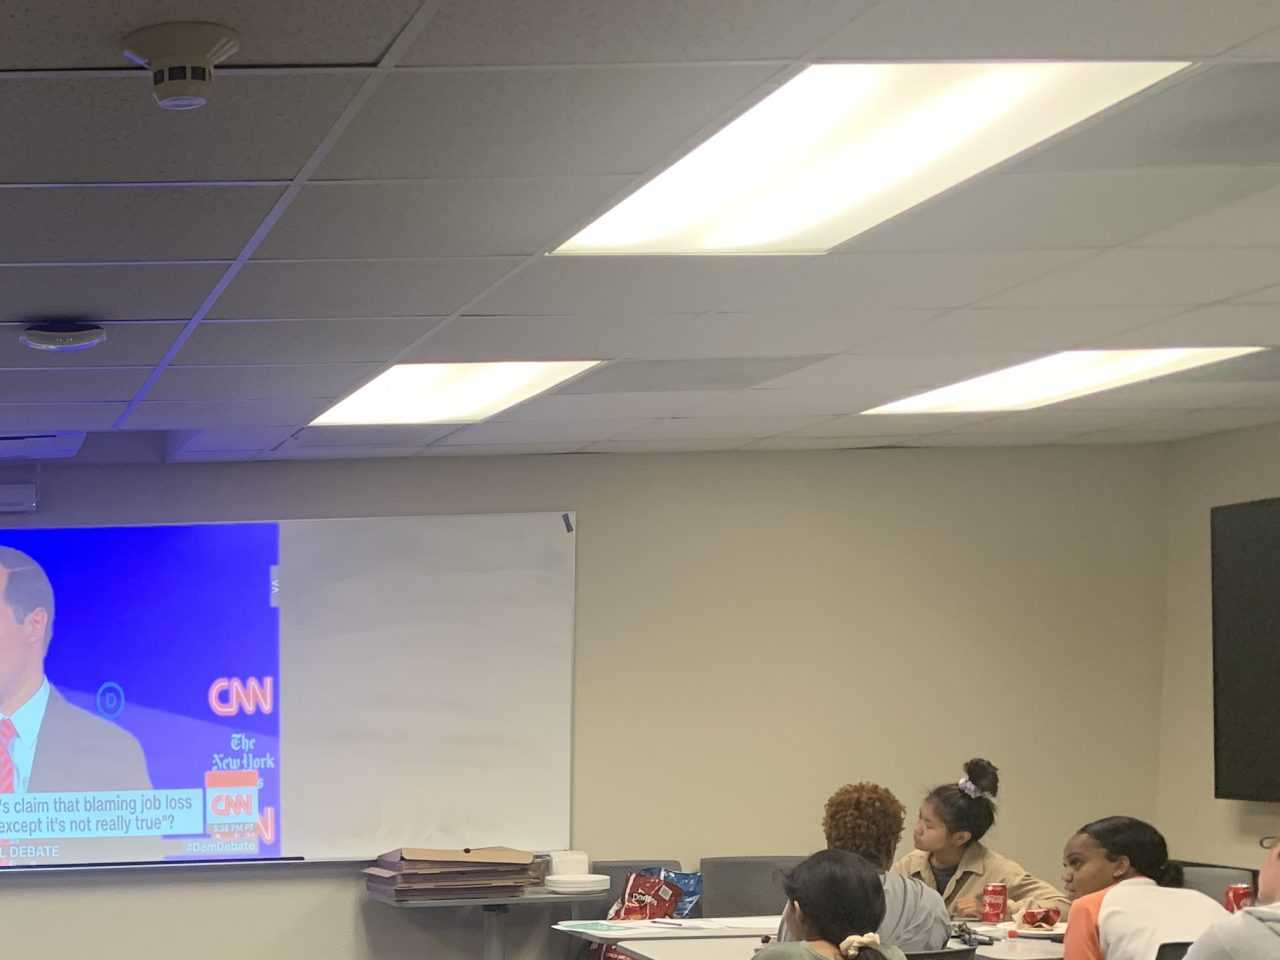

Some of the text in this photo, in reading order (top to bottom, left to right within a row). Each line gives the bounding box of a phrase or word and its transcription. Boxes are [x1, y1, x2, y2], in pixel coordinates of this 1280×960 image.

[208, 677, 274, 716] CNN
[231, 733, 256, 751] The
[212, 753, 275, 771] New York
[14, 798, 50, 814] claim
[54, 797, 80, 813] that
[84, 795, 136, 815] blaming
[140, 795, 162, 813] job
[165, 794, 193, 811] loss
[211, 793, 253, 816] CNN
[46, 818, 68, 833] it's
[71, 817, 92, 833] not
[95, 815, 130, 834] really
[135, 814, 175, 831] true"?
[9, 845, 61, 858] DEBATE
